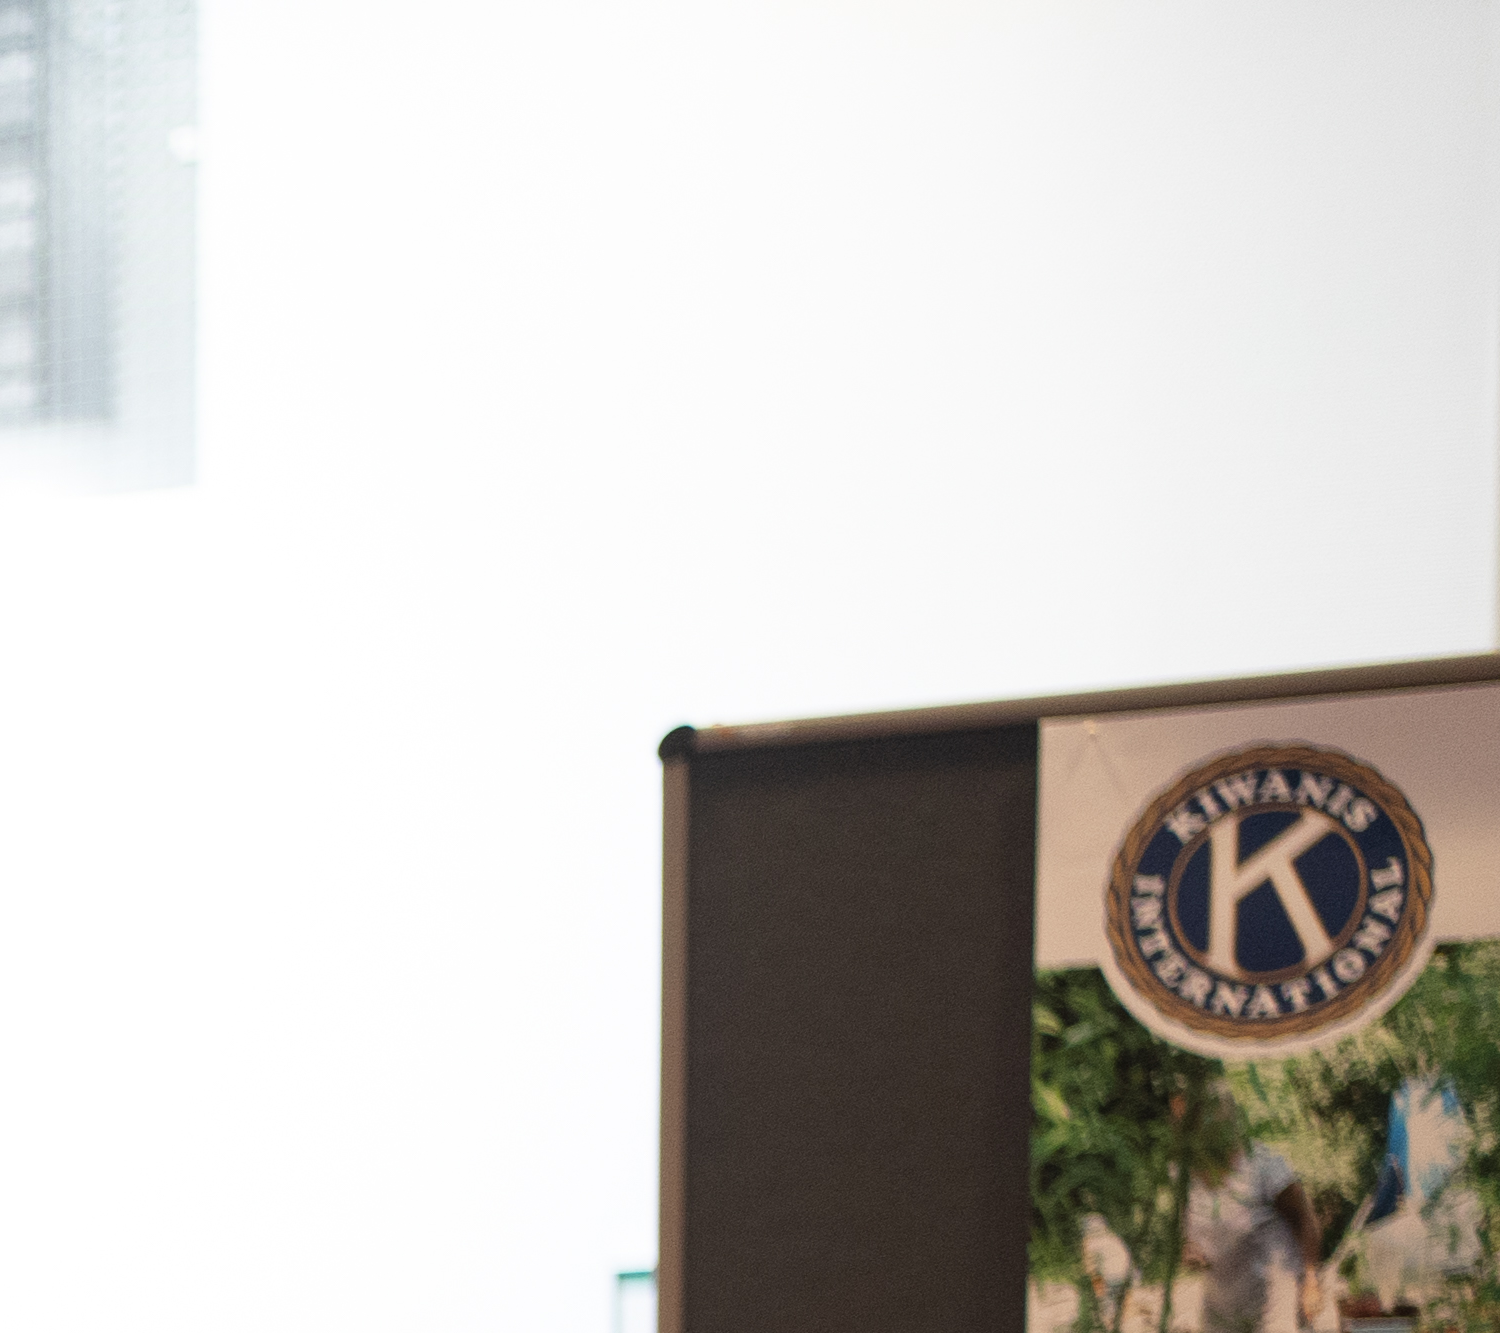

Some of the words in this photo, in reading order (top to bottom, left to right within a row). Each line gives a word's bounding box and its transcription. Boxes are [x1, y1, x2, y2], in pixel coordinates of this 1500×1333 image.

[1165, 767, 1378, 845] KIWANIS
[1131, 856, 1407, 1020] INTERNATIONAL
[1206, 811, 1340, 979] K
